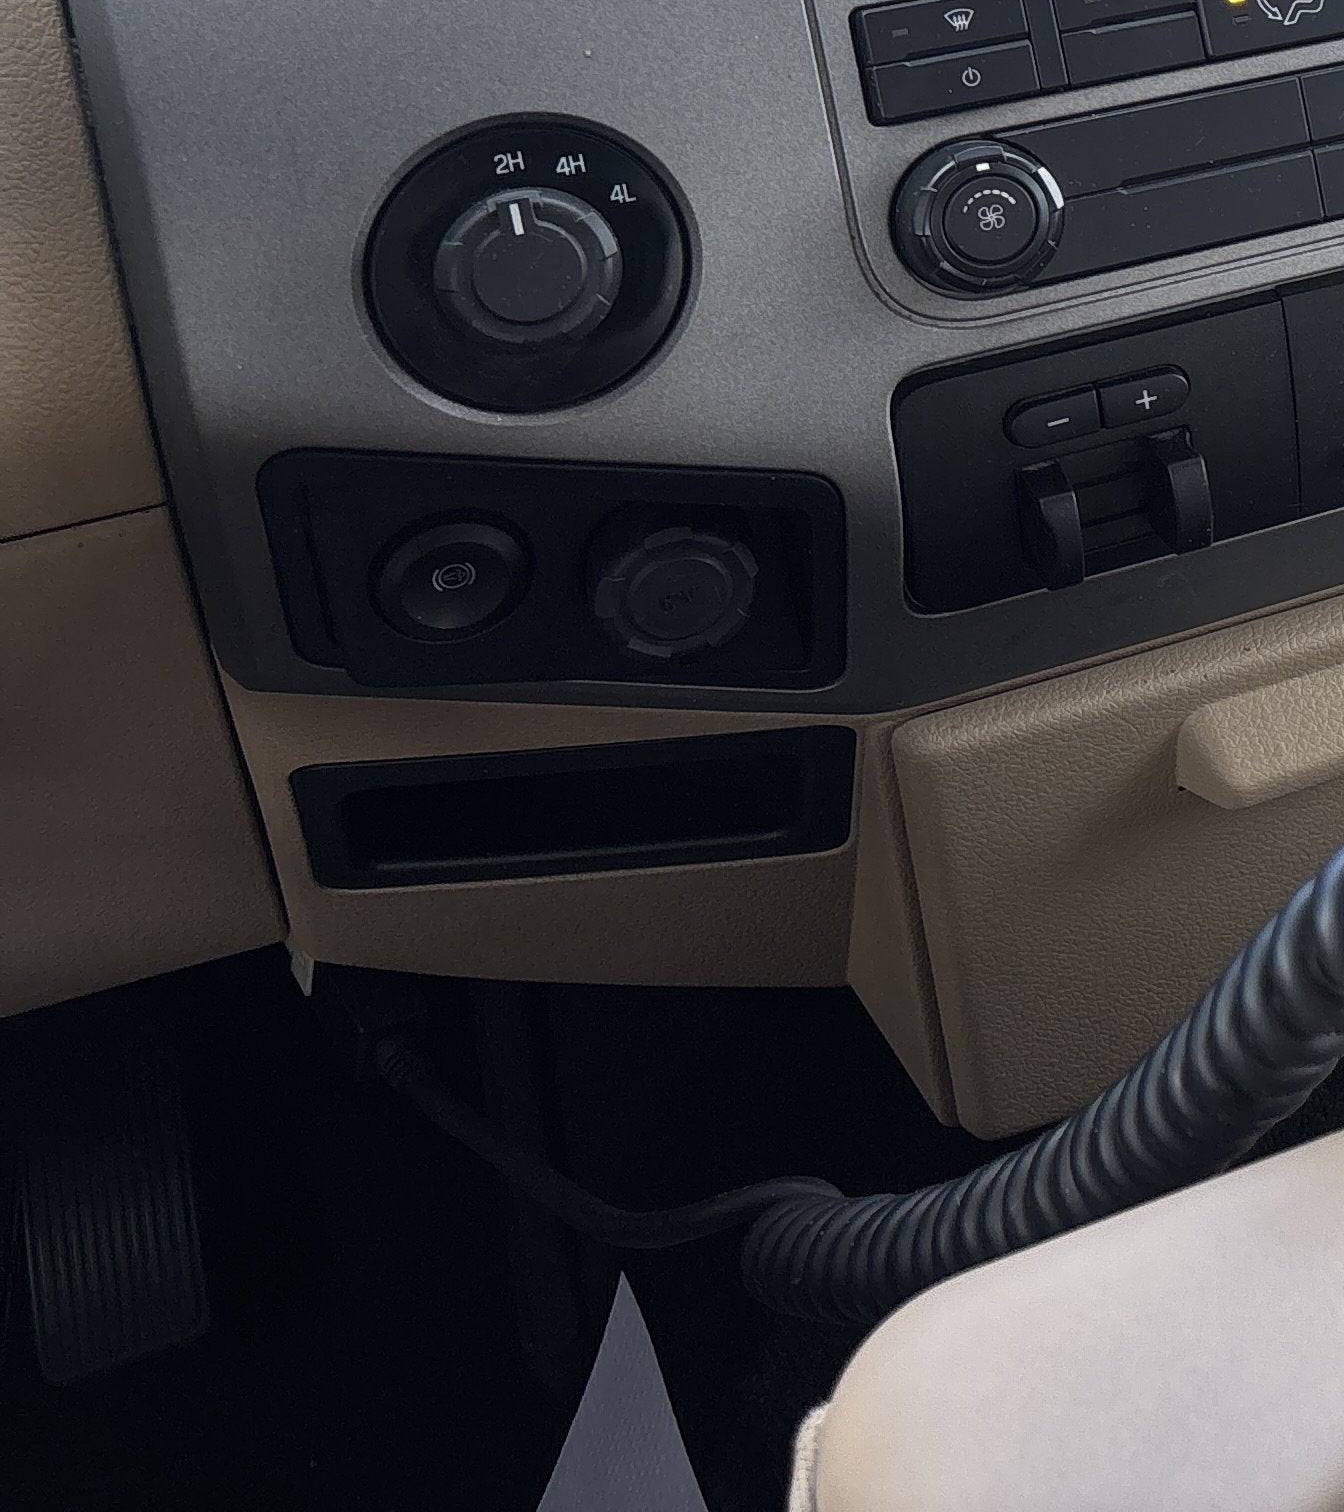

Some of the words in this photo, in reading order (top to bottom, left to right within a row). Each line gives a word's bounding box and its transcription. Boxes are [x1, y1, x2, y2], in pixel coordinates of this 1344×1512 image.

[493, 150, 526, 175] 2H
[556, 153, 587, 176] 4H
[610, 184, 637, 204] 4L
